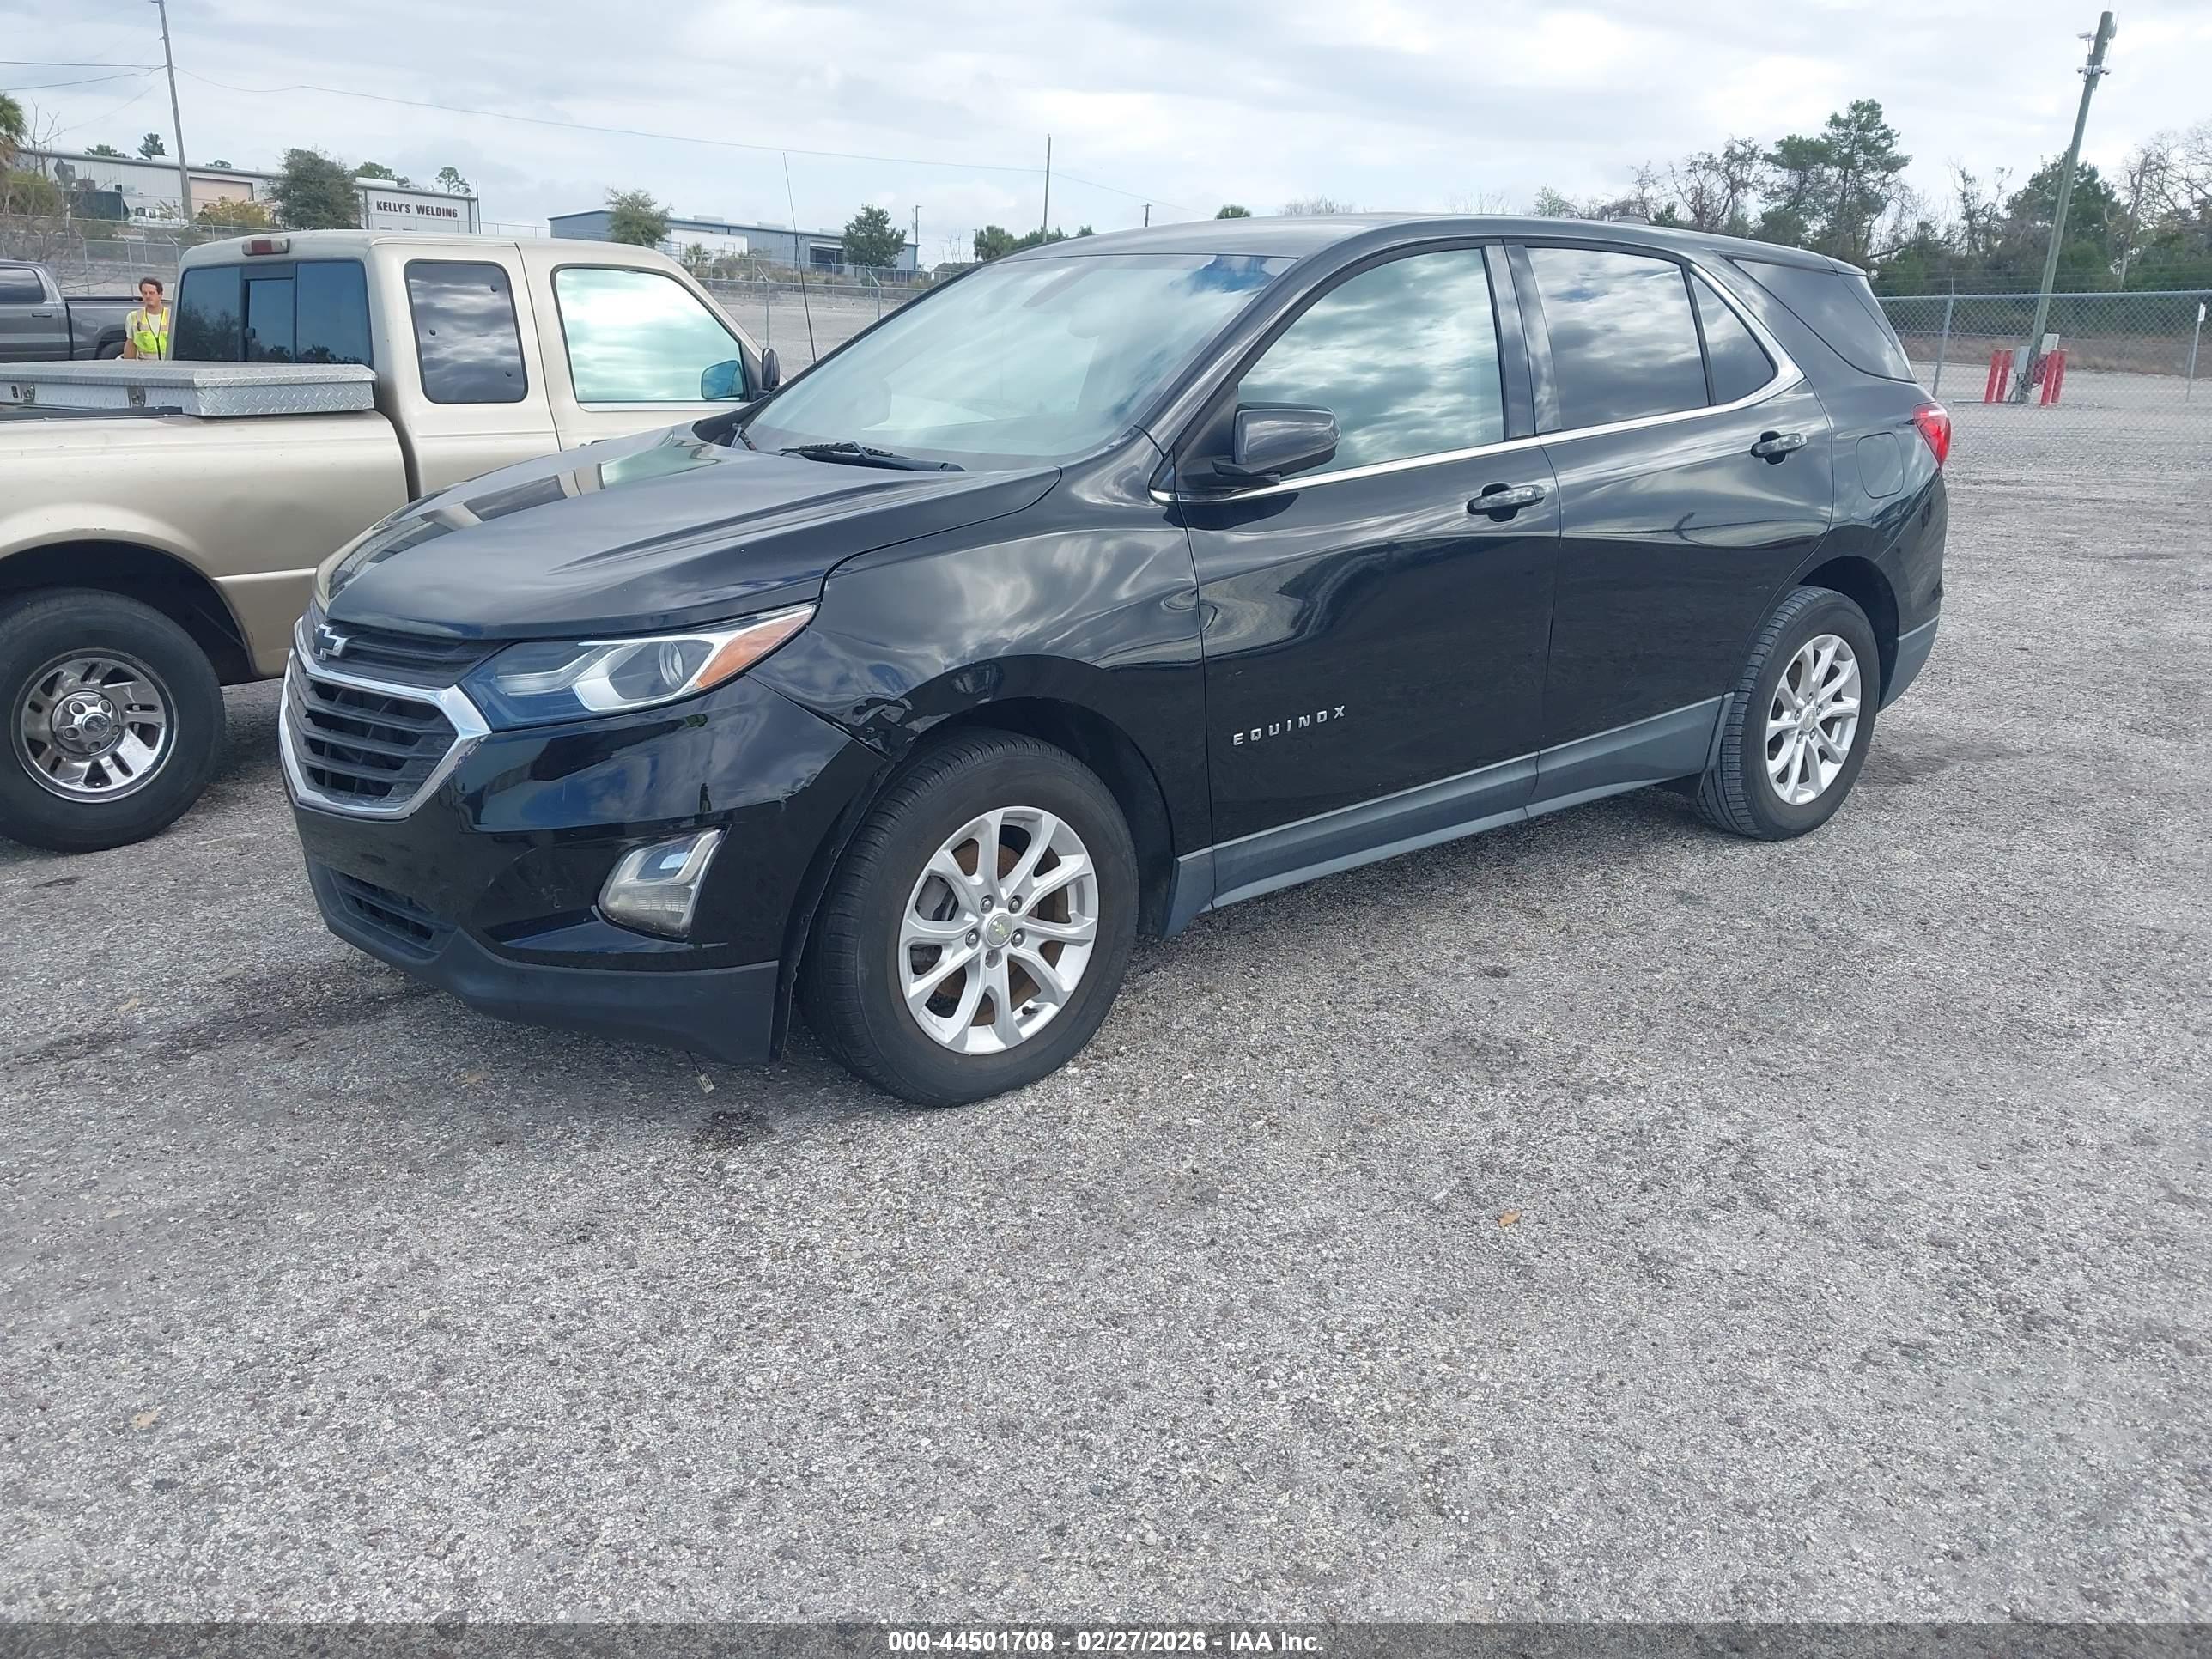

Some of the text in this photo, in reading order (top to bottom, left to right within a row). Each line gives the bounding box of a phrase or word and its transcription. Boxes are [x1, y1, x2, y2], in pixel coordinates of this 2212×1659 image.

[376, 200, 458, 218] KELLY'S WELDING
[1232, 705, 1346, 746] EQUINOX
